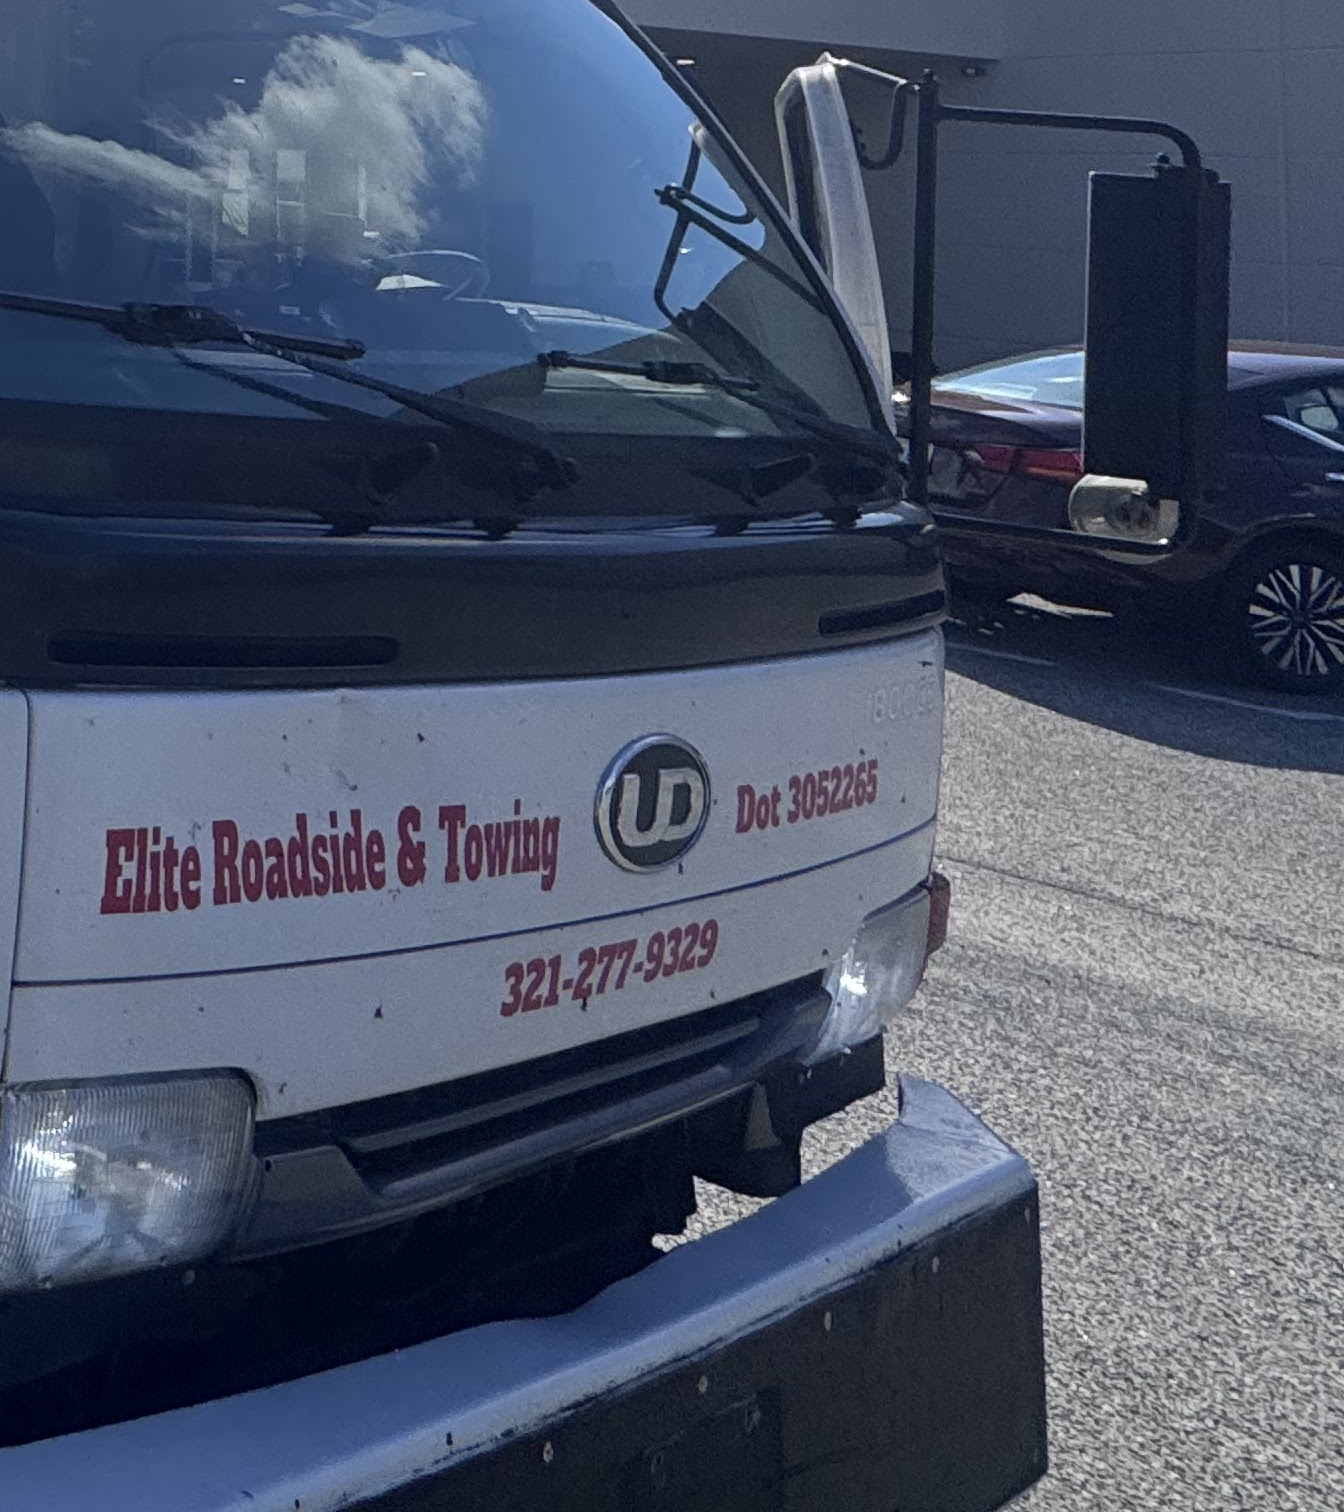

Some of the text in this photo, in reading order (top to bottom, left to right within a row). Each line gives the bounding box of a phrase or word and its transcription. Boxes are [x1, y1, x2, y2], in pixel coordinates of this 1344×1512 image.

[616, 766, 708, 848] UD
[735, 758, 879, 834] Dot 3052265
[100, 799, 561, 915] Elite Roadside & Towing
[499, 918, 719, 1017] 321-277-9329
